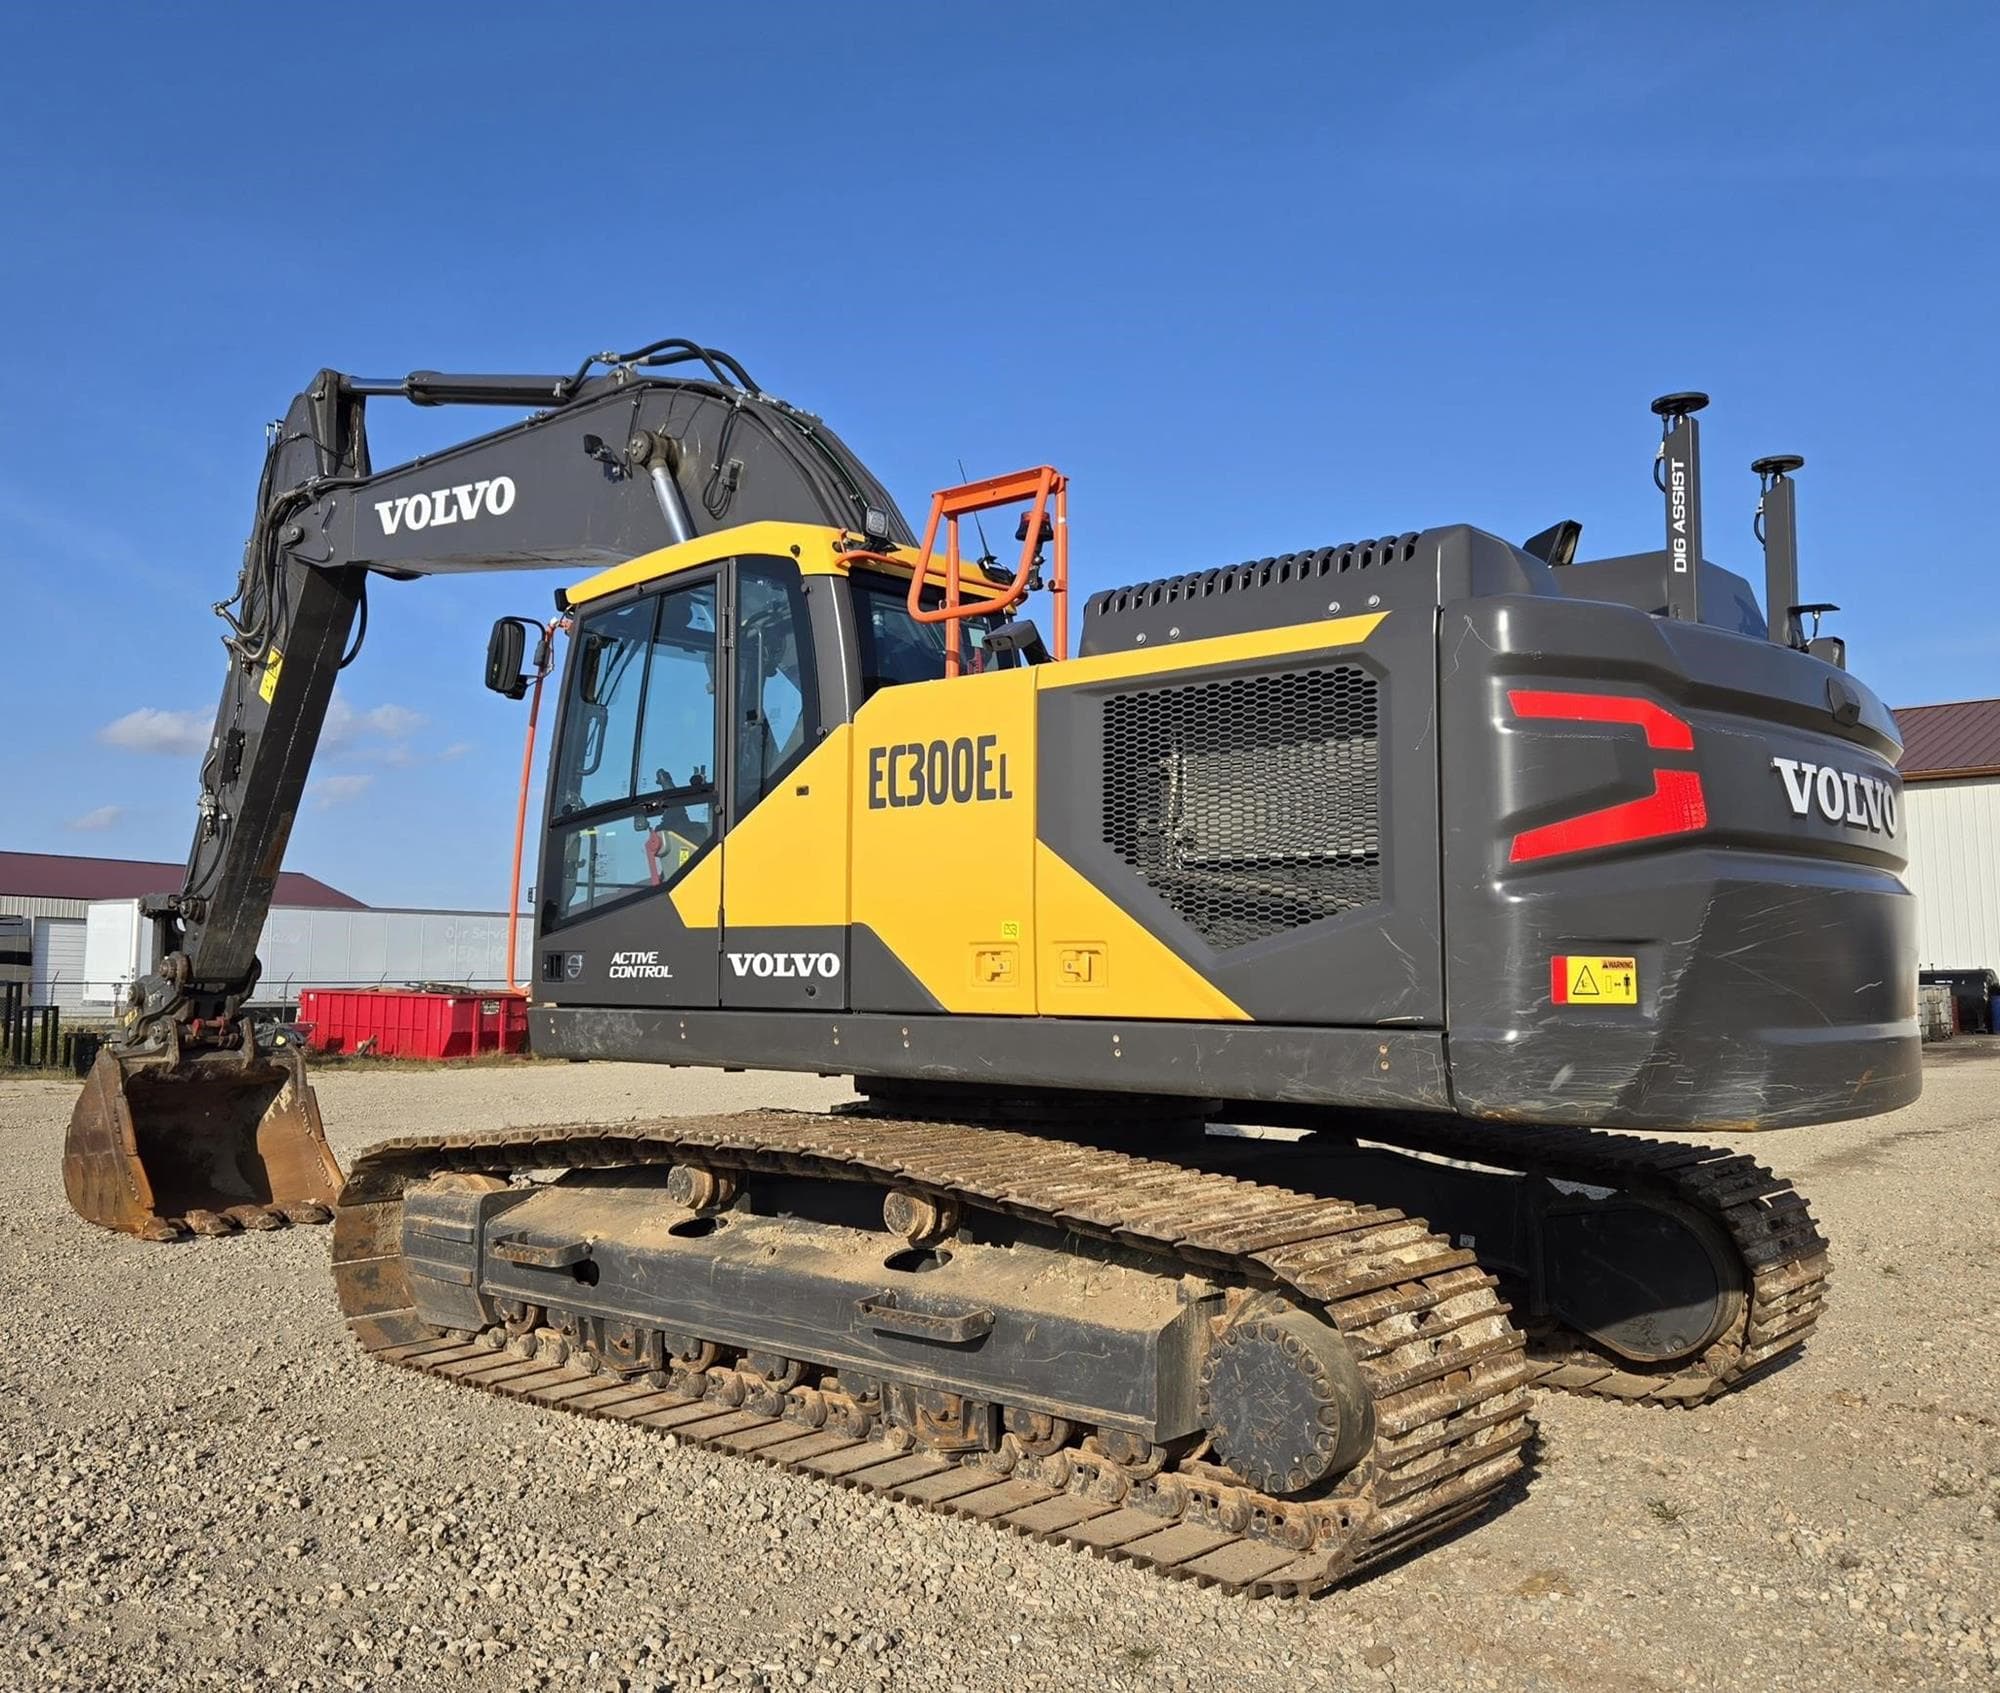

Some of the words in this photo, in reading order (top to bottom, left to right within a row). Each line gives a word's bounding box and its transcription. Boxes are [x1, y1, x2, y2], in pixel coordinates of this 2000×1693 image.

[374, 476, 516, 535] VOLVO
[1671, 457, 1686, 533] ASSIST
[1673, 538, 1687, 573] DIG
[1772, 756, 1898, 835] VOLVO
[609, 965, 673, 978] CONTROL
[611, 951, 659, 964] ACTIVE
[727, 952, 841, 978] VOLVO
[1608, 960, 1633, 969] WARNING
